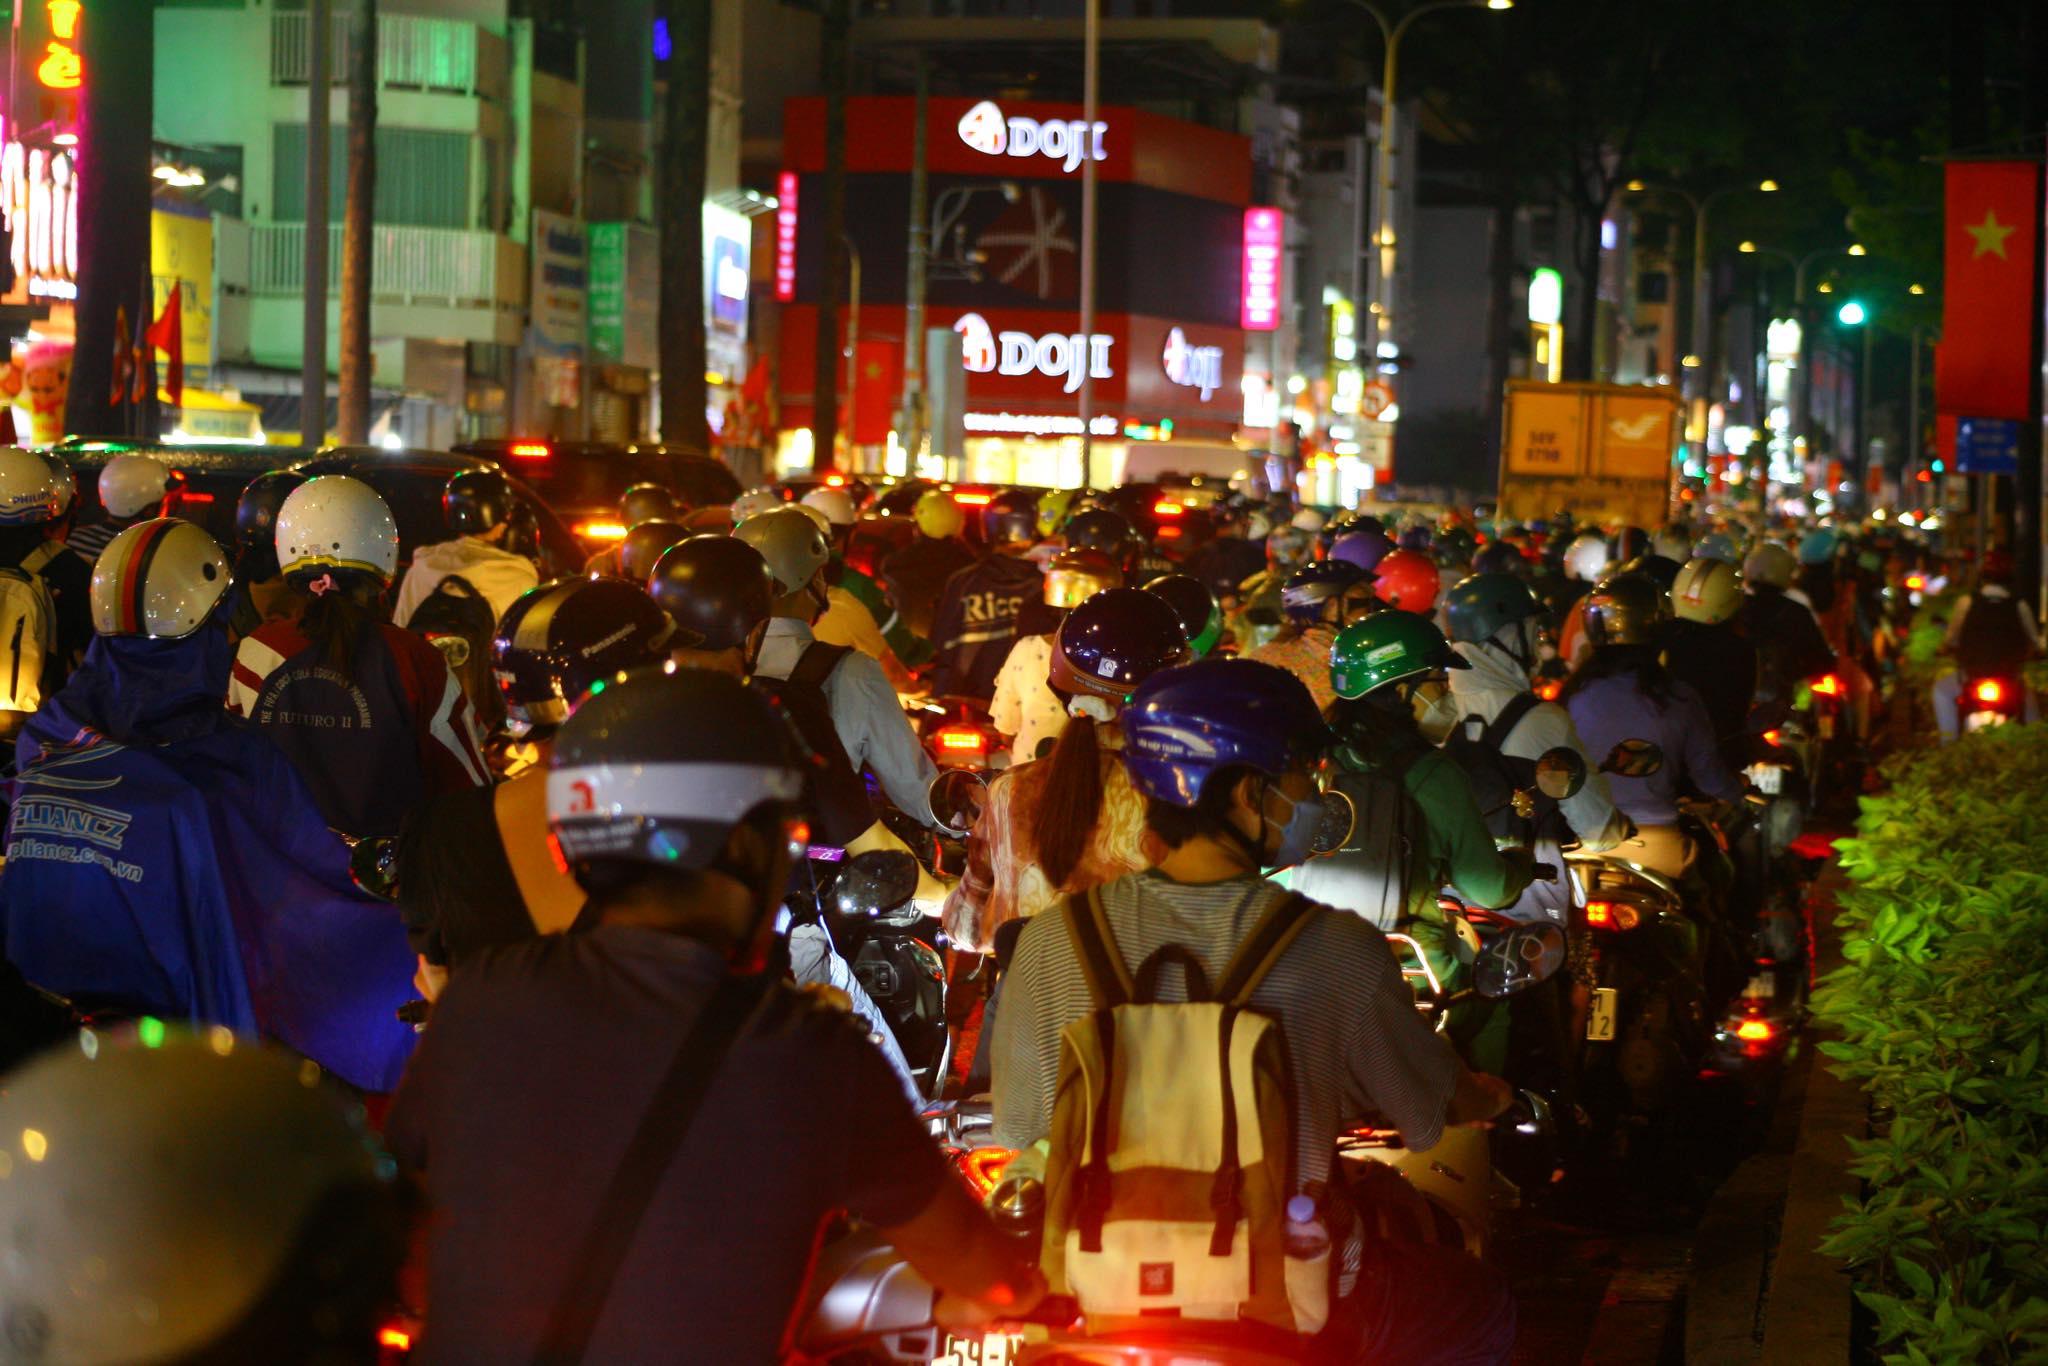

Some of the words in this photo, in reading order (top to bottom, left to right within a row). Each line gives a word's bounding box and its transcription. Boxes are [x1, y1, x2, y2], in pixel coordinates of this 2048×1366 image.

[1007, 117, 1109, 172] DOJI
[998, 331, 1114, 393] DOJI
[581, 622, 637, 659] Panasonic
[280, 711, 335, 728] FUTURO
